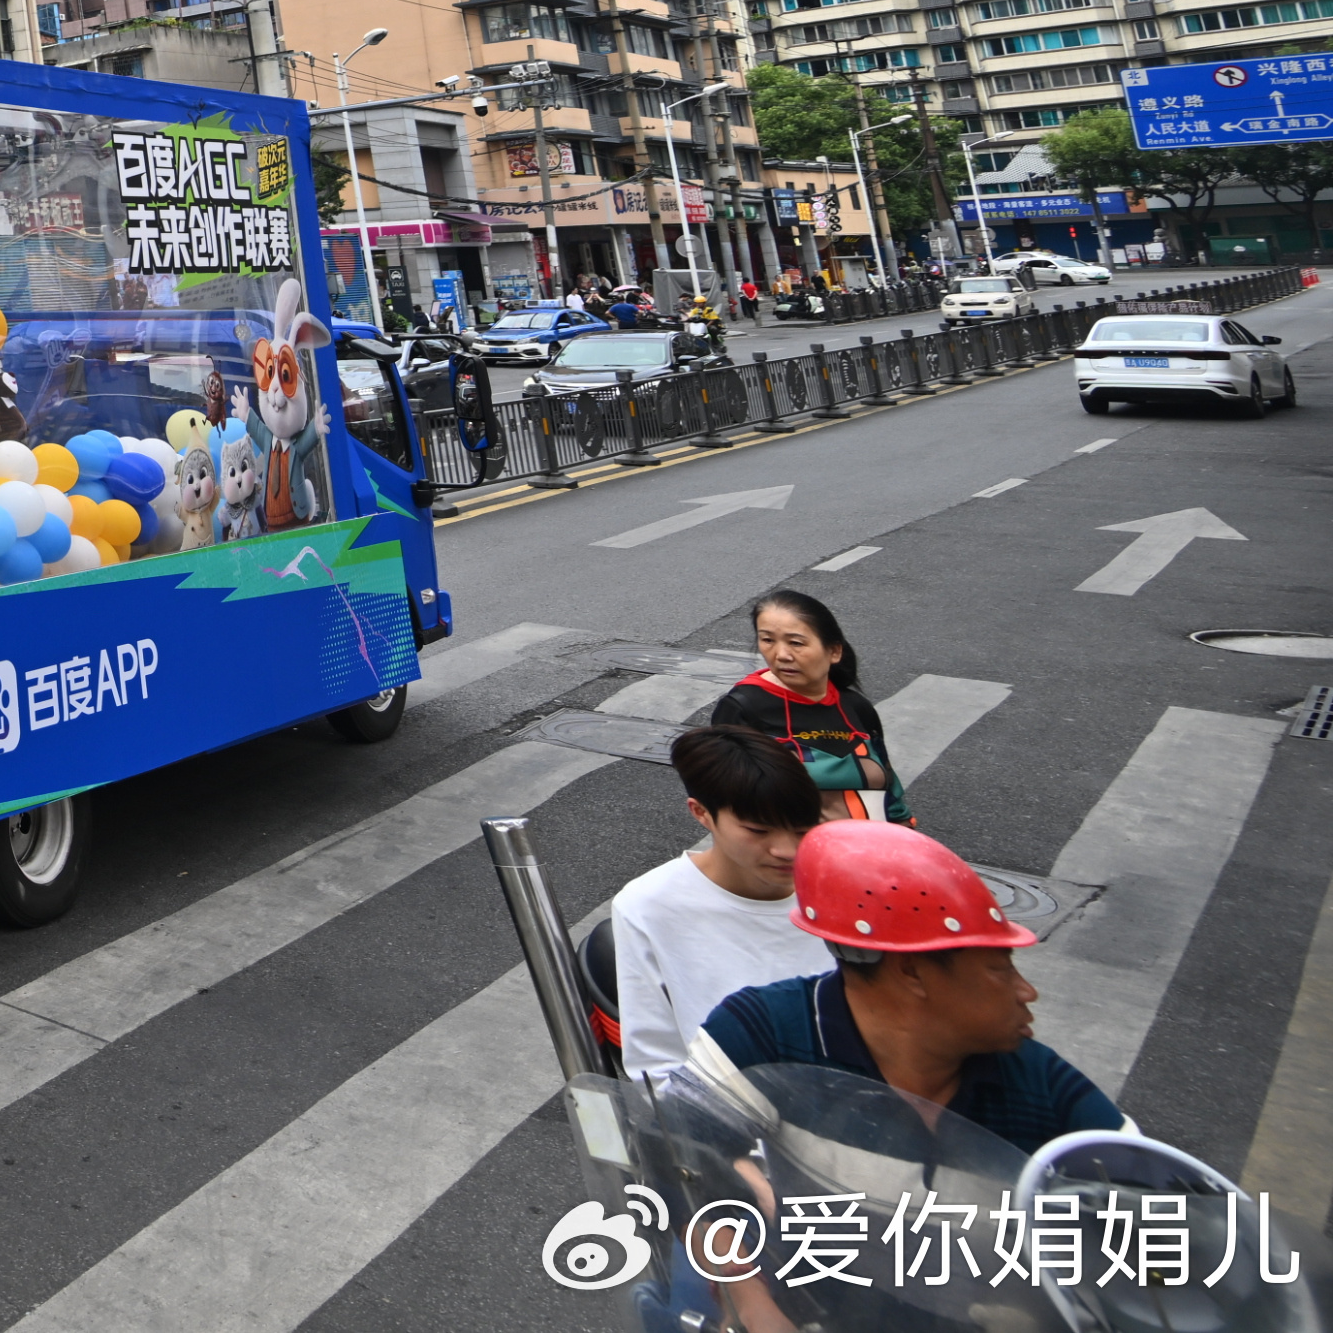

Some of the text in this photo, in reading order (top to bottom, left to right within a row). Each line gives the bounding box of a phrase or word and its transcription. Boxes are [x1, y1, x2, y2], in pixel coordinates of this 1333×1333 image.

[1127, 70, 1141, 80] 北
[1270, 75, 1307, 86] Xinglong
[1138, 94, 1204, 112] 遵义路
[1145, 120, 1211, 136] 人民大道
[1248, 117, 1319, 130] 瑞金南路
[1146, 137, 1186, 145] Renmin
[257, 139, 287, 171] 破次元
[113, 133, 251, 202] 百度AIGC
[257, 162, 288, 196] 嘉年华
[128, 206, 291, 270] 未来创作联赛
[24, 638, 159, 731] 百度APP
